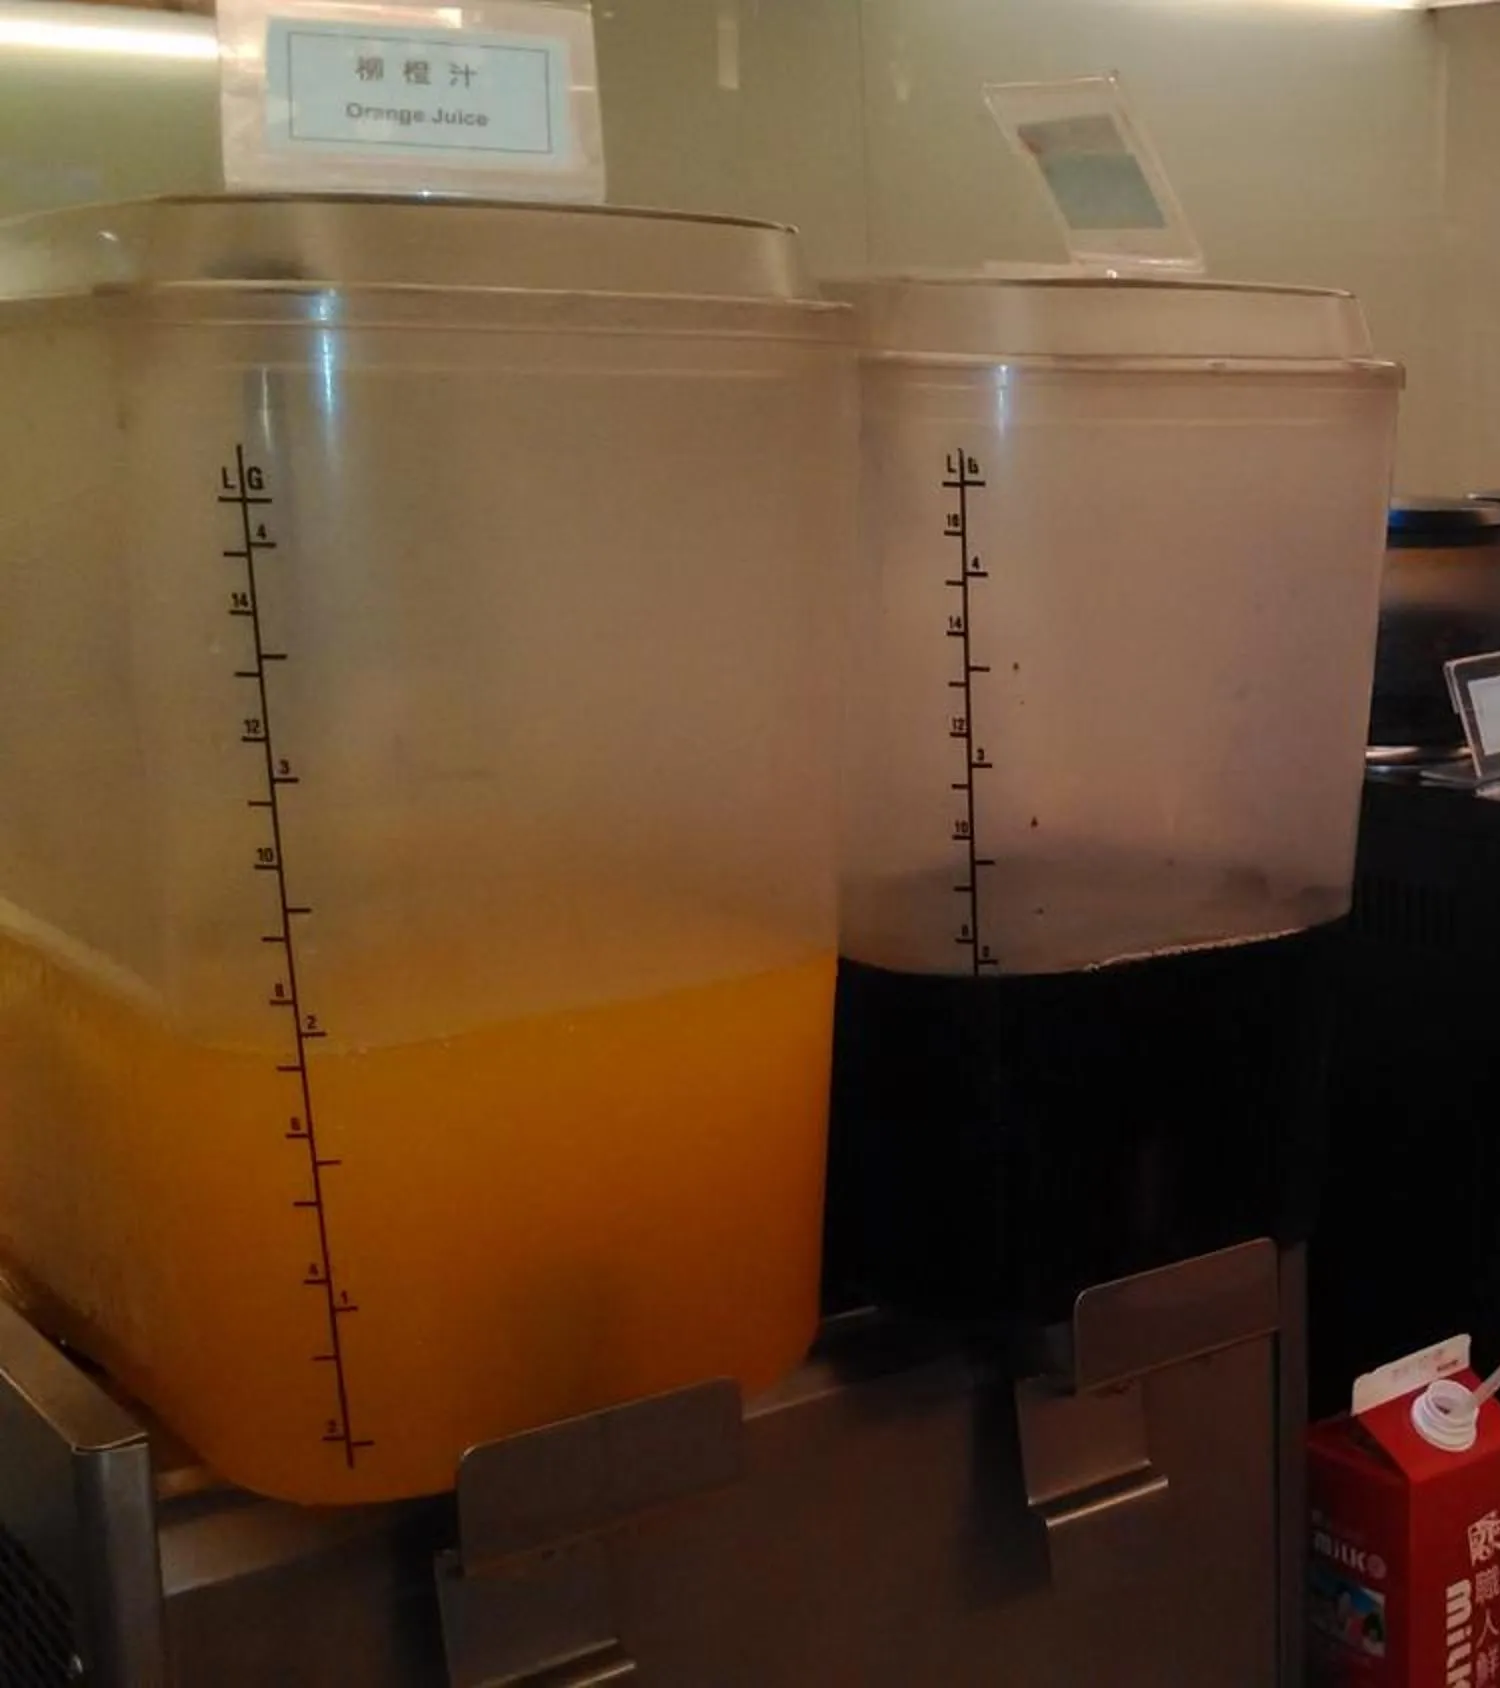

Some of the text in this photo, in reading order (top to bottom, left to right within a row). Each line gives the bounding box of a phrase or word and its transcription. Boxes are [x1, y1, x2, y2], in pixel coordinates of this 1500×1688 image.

[354, 55, 479, 90] 柳橙汁
[345, 101, 491, 128] Orange Juice
[947, 454, 957, 474] L
[222, 466, 265, 491] L G
[256, 524, 267, 541] 4
[231, 592, 250, 608] 14
[948, 615, 962, 629] 14
[243, 719, 261, 735] 12
[951, 717, 966, 732] 12
[278, 759, 290, 775] 3
[256, 847, 274, 863] 10
[306, 1014, 318, 1030] 2
